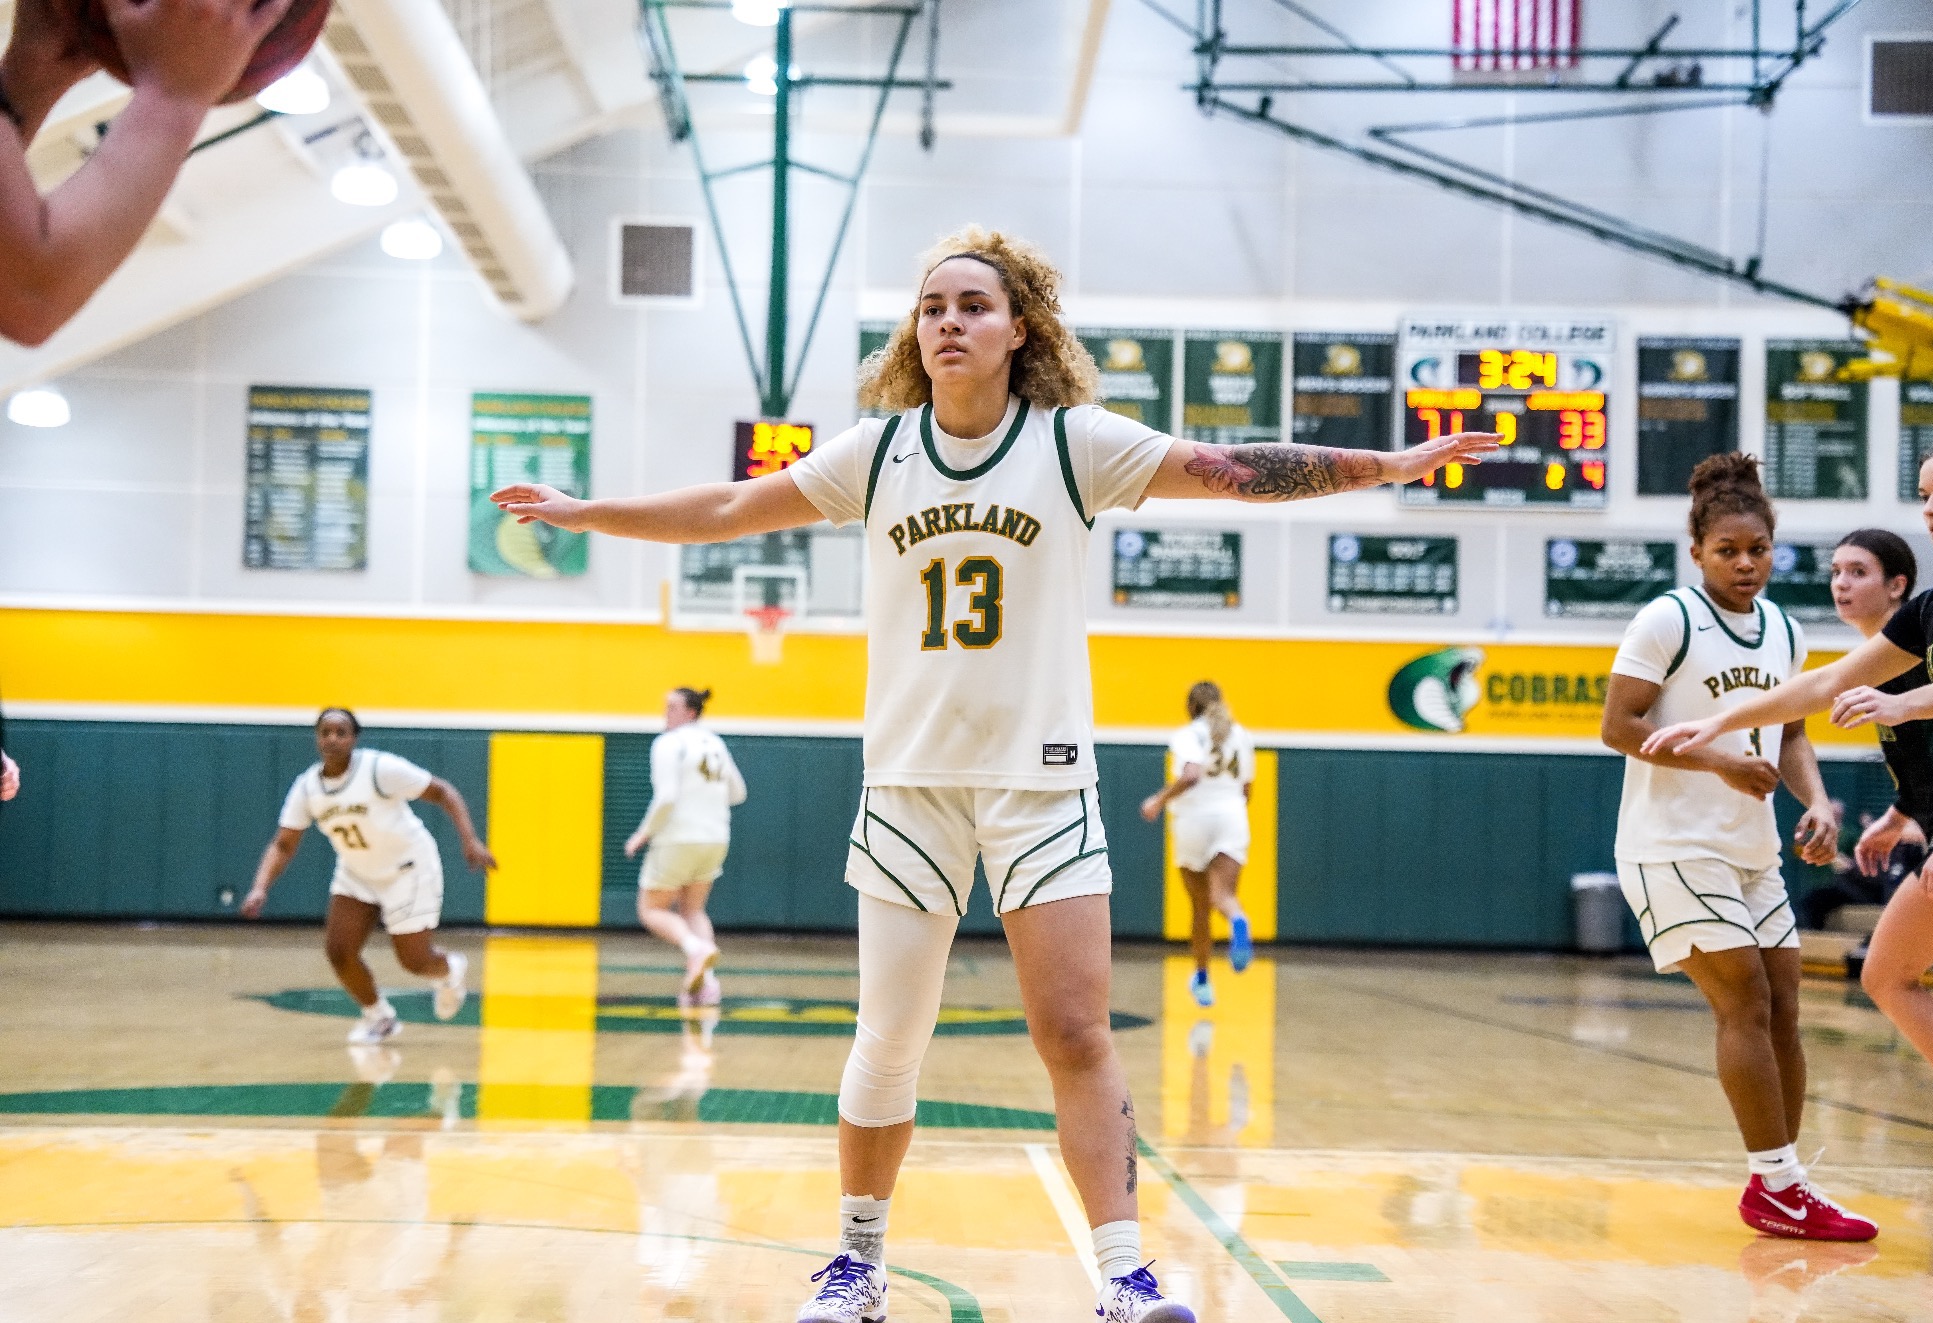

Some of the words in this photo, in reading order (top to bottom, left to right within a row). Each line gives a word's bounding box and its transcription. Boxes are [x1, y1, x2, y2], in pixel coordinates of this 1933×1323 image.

[1479, 349, 1557, 390] 3:24
[1559, 411, 1606, 450] 33
[888, 503, 1042, 557] PARKLAND
[920, 555, 1004, 651] 13
[1486, 673, 1608, 705] COBRAS
[1703, 666, 1781, 699] PARKLA
[1206, 747, 1241, 779] 34
[332, 823, 369, 851] 21
